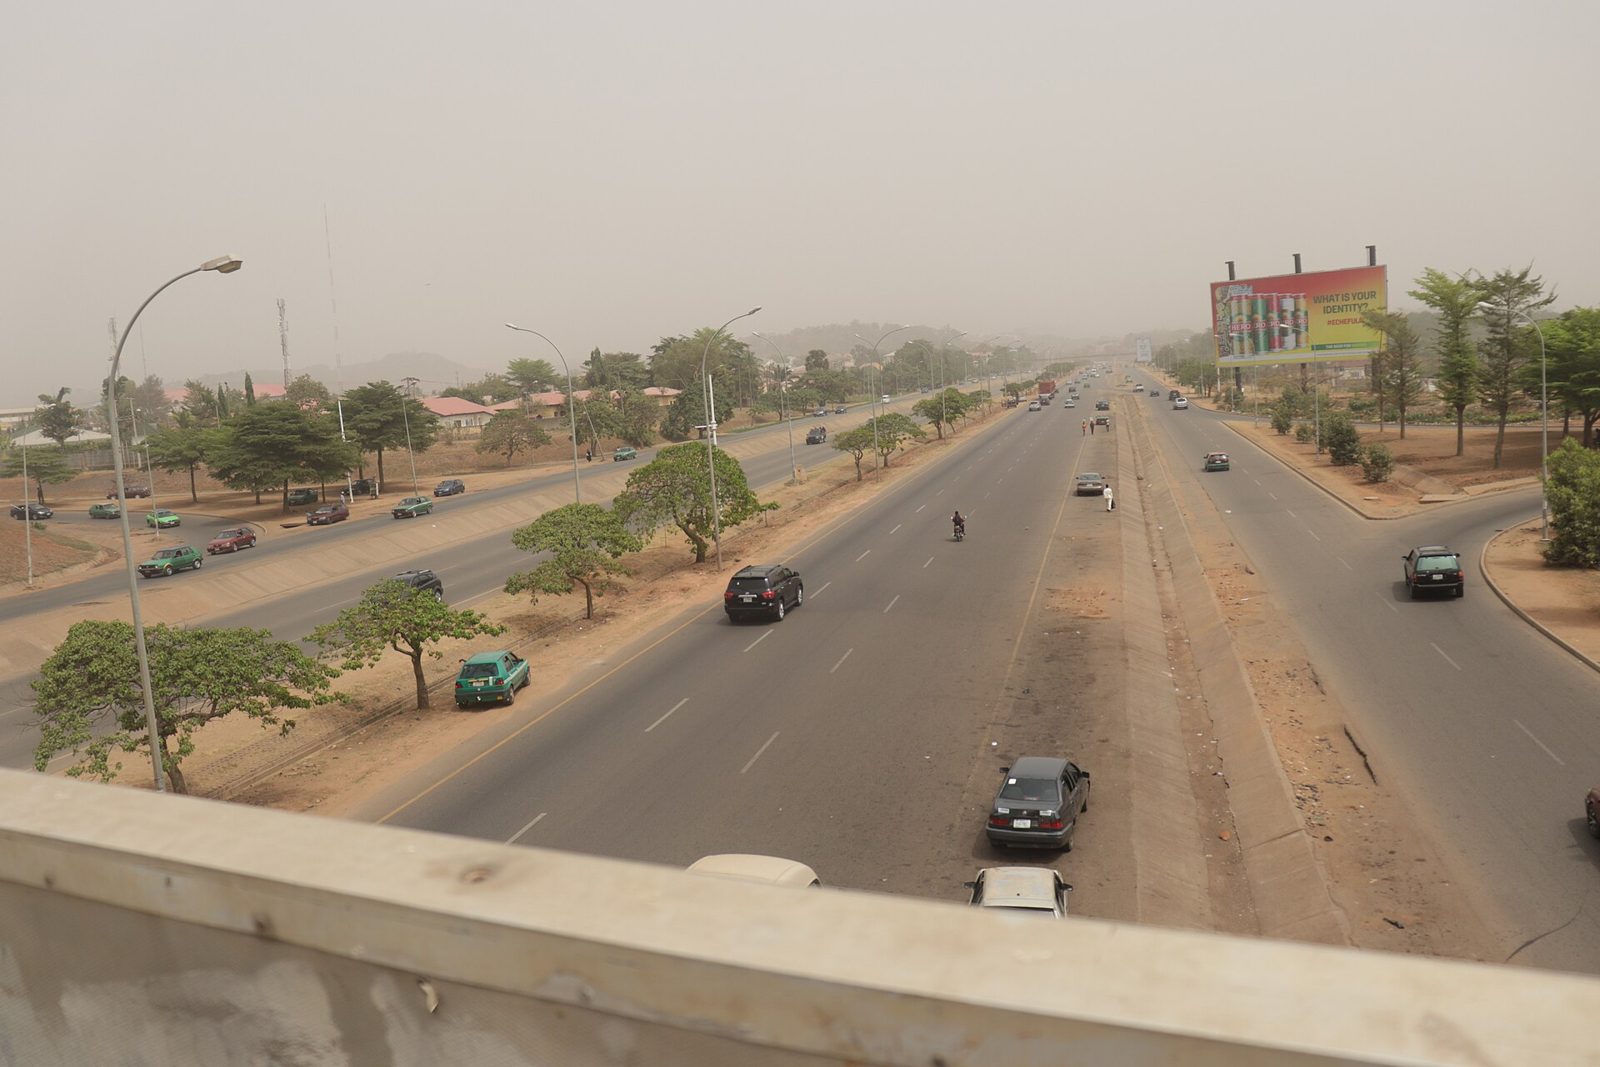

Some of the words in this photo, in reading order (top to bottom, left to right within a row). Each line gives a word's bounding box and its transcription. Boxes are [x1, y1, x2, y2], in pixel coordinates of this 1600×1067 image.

[1313, 294, 1341, 304] WHAT
[1341, 293, 1350, 302] IS
[1352, 291, 1377, 300] YOUR
[1323, 303, 1369, 314] IDENTITY?
[1231, 323, 1251, 331] HERO
